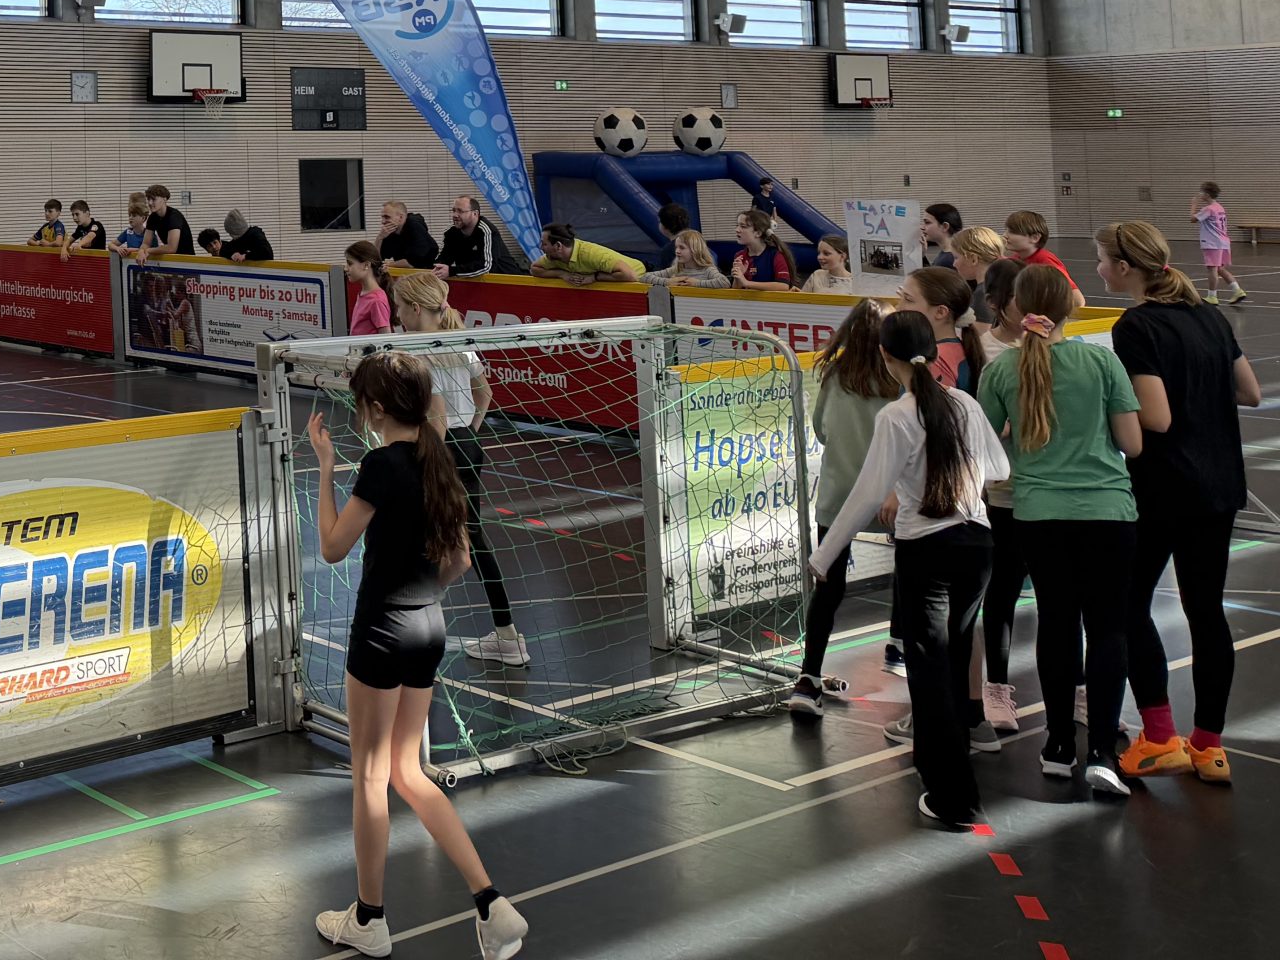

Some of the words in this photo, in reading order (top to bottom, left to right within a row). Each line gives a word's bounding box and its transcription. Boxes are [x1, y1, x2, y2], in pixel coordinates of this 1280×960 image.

[294, 86, 315, 95] HEIM
[342, 87, 363, 96] GAST
[846, 201, 907, 217] KLASSE
[863, 213, 891, 237] 5A
[186, 278, 236, 301] Shopping
[238, 287, 257, 302] pur
[259, 285, 275, 300] bis
[278, 290, 292, 302] 20
[295, 288, 317, 304] Uhr
[242, 305, 273, 321] Montag
[282, 309, 318, 326] Samstag
[711, 489, 735, 519] ab
[741, 491, 768, 516] 40
[735, 557, 797, 578] Förderverein
[76, 654, 124, 679] SPORT
